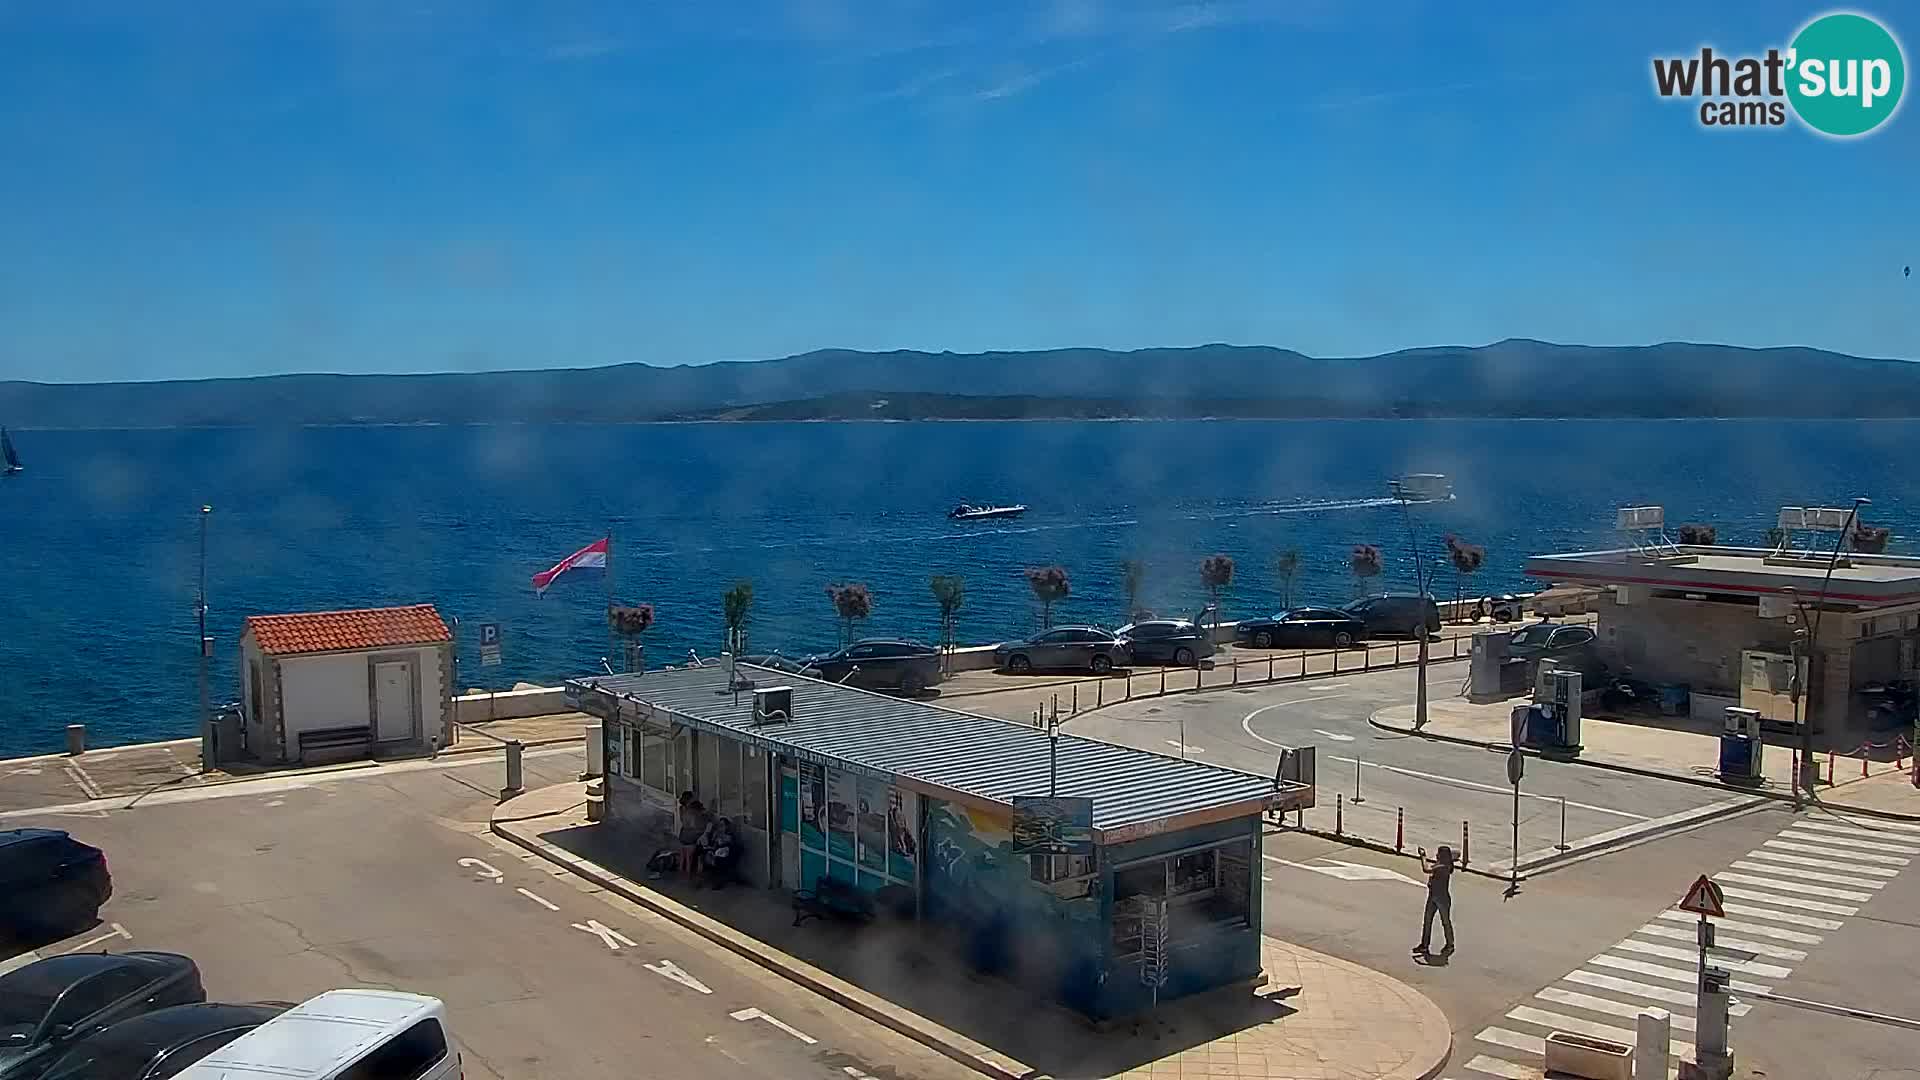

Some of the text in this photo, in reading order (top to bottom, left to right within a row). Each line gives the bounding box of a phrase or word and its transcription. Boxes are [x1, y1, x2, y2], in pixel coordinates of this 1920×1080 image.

[485, 626, 496, 642] P
[794, 748, 809, 760] BUS
[809, 752, 839, 769] STATION
